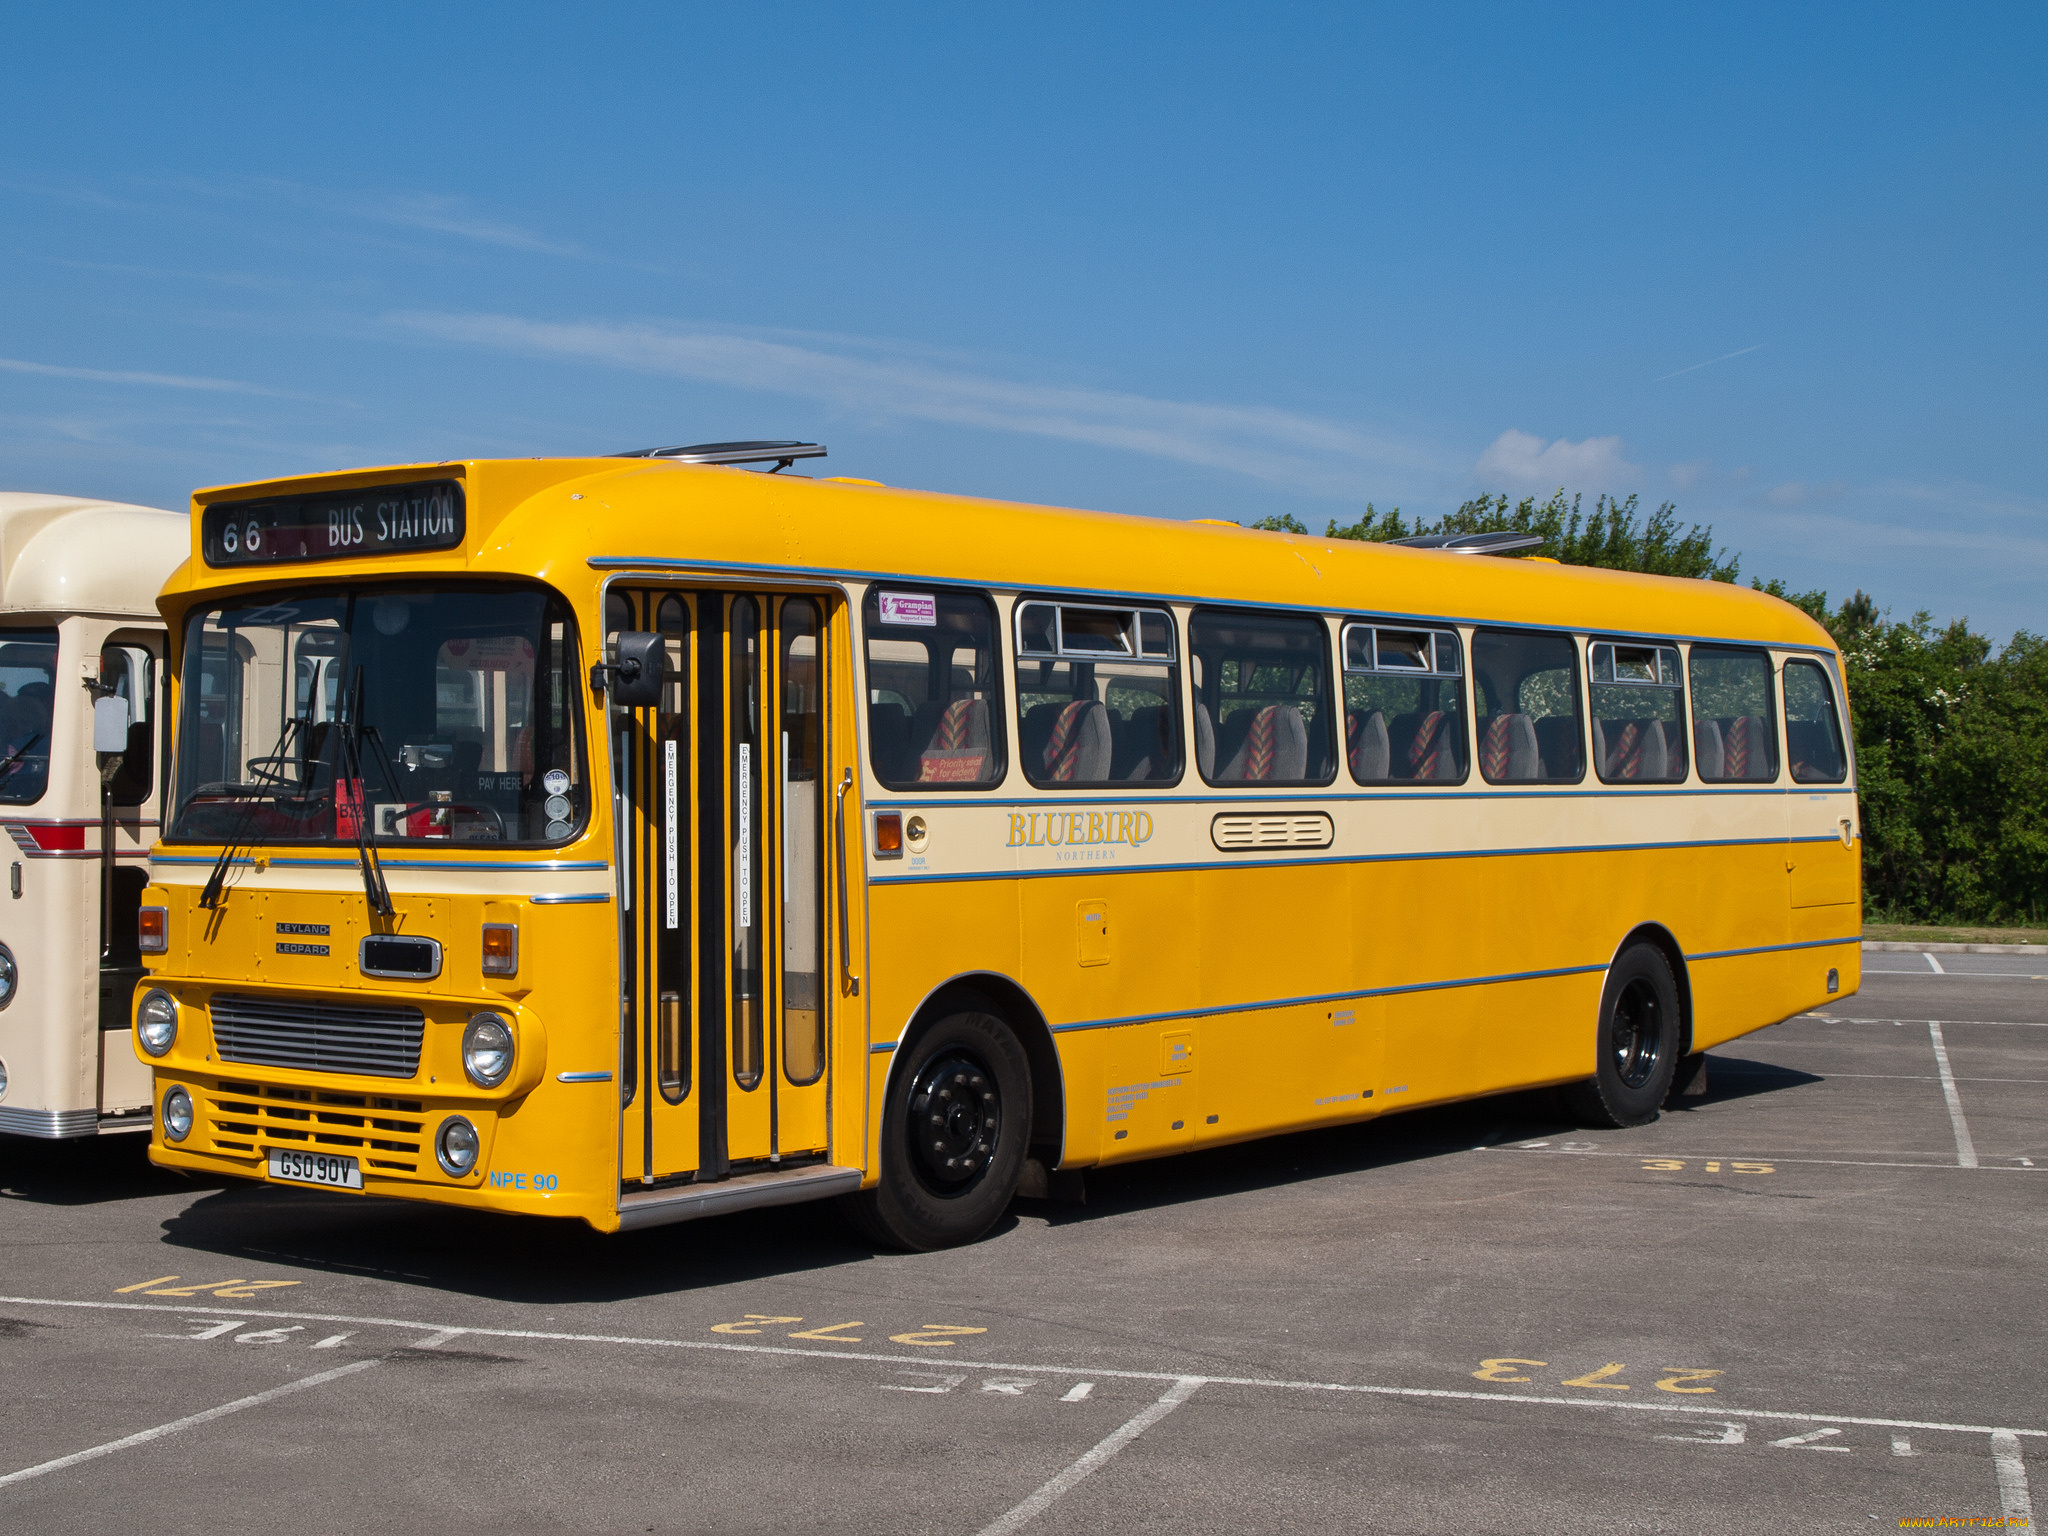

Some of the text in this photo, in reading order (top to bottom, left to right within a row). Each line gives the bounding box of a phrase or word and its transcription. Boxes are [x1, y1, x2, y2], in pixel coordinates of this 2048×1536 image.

[223, 494, 454, 553] 66 BUS STATION
[899, 600, 933, 612] Grampian
[940, 756, 983, 770] Priority seat
[938, 767, 977, 778] for elderly
[478, 776, 522, 791] PAY HERE
[667, 743, 675, 822] EMERGENCY
[1006, 810, 1153, 848] BLUEBIRD
[1055, 850, 1116, 861] NORTHERN
[669, 868, 675, 886] TO
[742, 868, 748, 886] TO
[279, 923, 327, 934] LEYLAND
[279, 943, 327, 954] LEOPARD
[281, 1152, 350, 1183] GSO 90V
[1641, 1159, 1777, 1174] 315
[490, 1171, 558, 1191] NPE 90
[113, 1275, 302, 1298] 271
[711, 1314, 988, 1346] 272
[1471, 1357, 1726, 1394] 273
